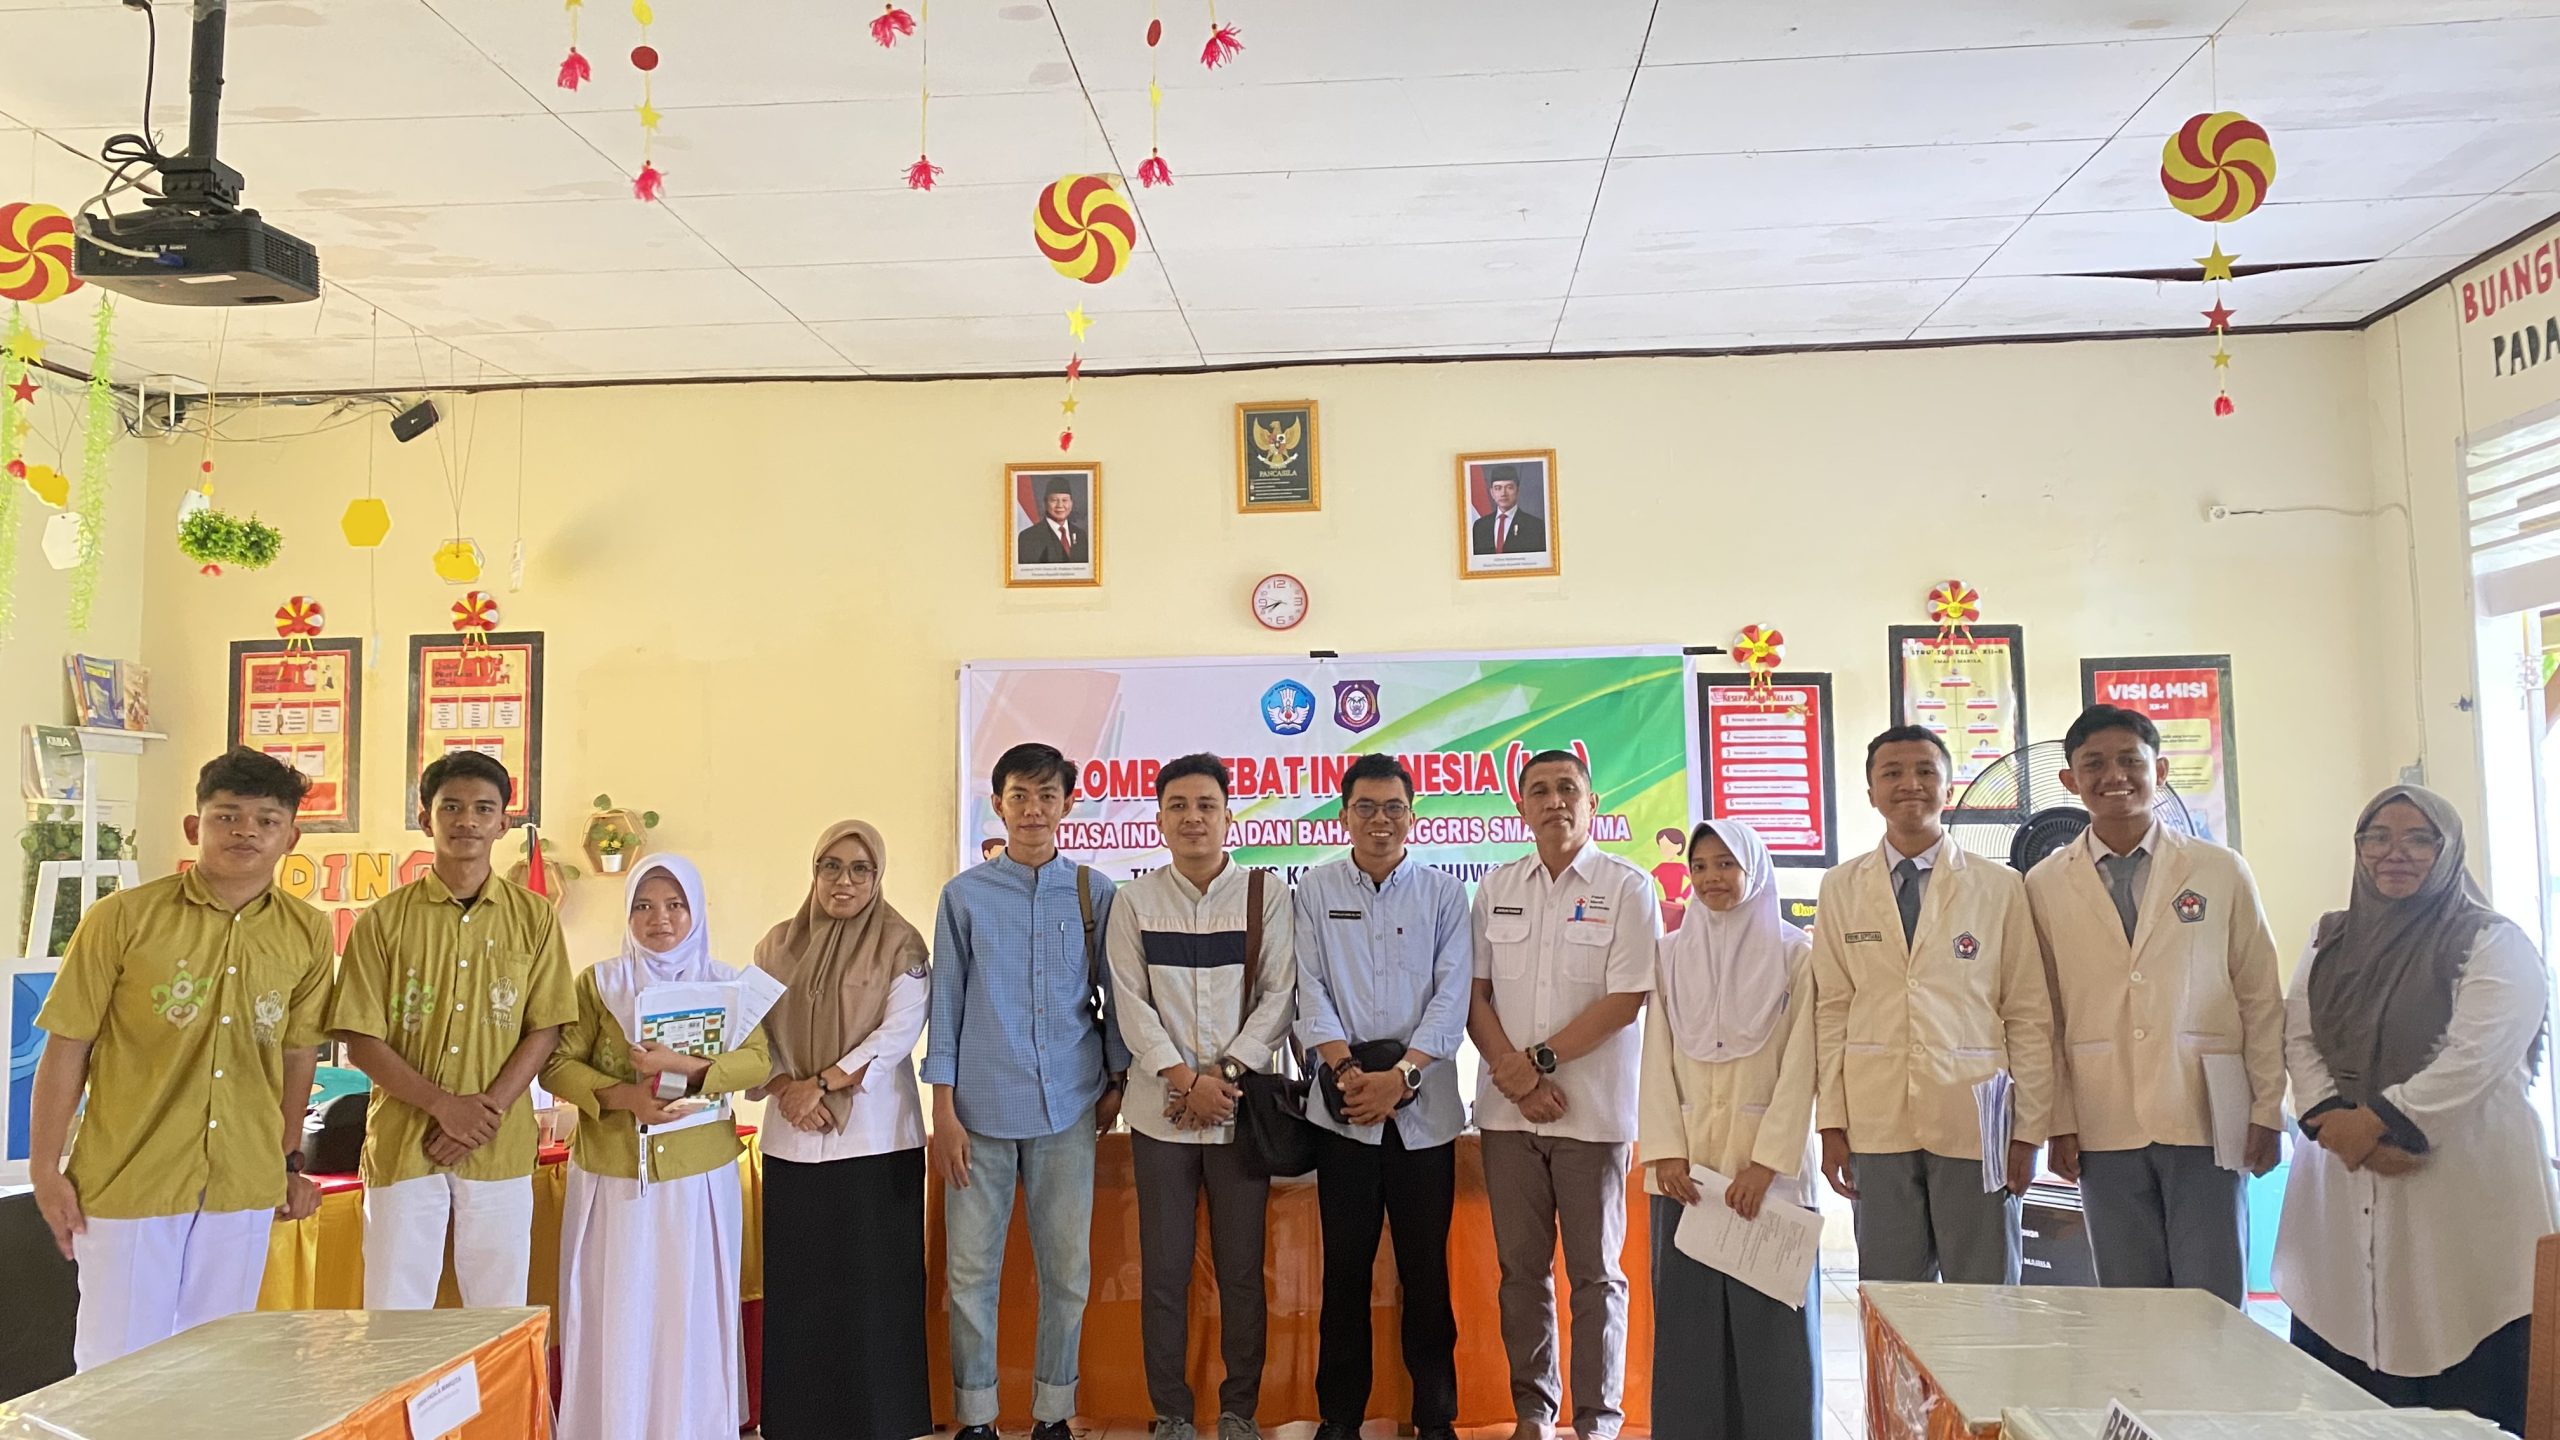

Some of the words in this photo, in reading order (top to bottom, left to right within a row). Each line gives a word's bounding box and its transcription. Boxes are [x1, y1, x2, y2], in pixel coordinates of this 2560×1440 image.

[1273, 580, 1286, 588] 12
[2107, 683, 2147, 700] VISI
[2149, 683, 2165, 699] &
[2166, 682, 2208, 699] MISI
[1072, 758, 1163, 802] OMB
[1219, 755, 1306, 799] EBAT
[1310, 752, 1502, 797] INNESIA
[1054, 822, 1119, 849] HASA
[1246, 820, 1292, 846] DAN
[1298, 819, 1354, 845] BAHA
[1403, 816, 1485, 844] NGGRIS
